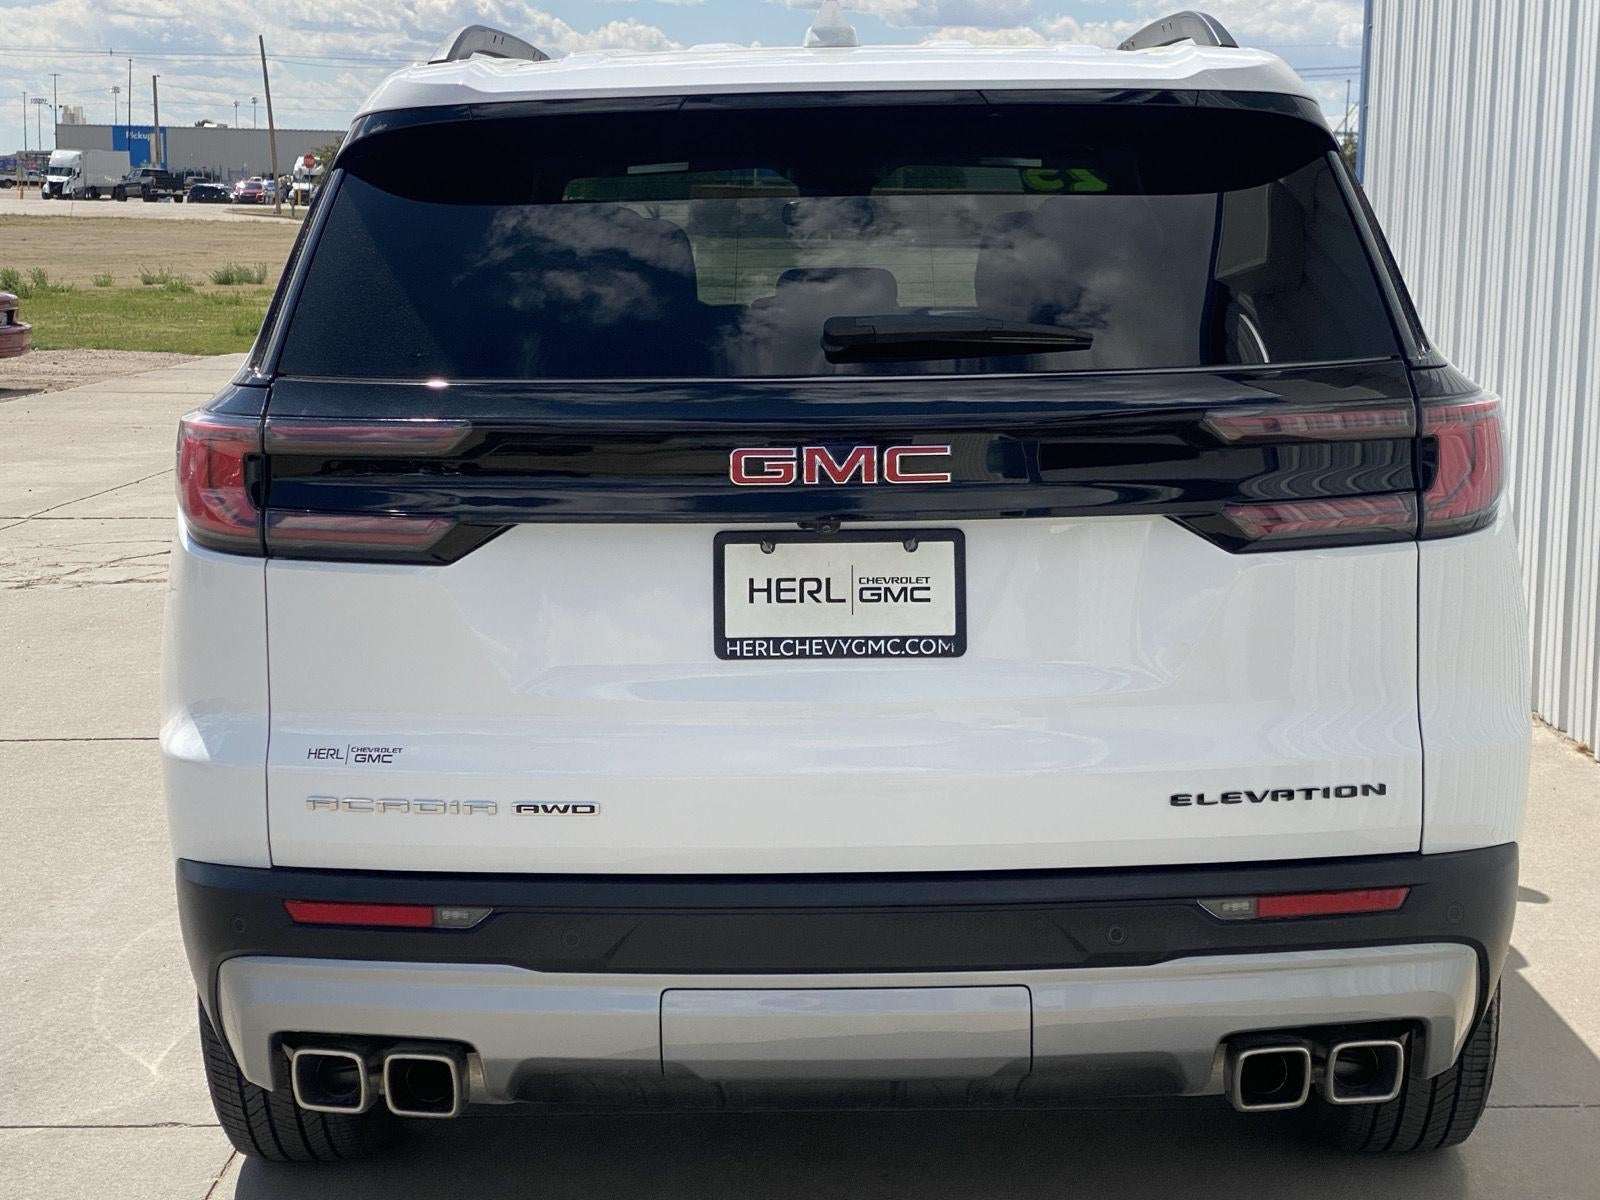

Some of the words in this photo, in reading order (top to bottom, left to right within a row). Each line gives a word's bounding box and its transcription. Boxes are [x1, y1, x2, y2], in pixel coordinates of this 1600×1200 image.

[729, 446, 951, 485] GMC
[858, 576, 931, 585] CHEVROLET
[748, 577, 846, 604] HERL
[858, 586, 931, 603] GMC
[726, 638, 955, 657] HERLCHEVYGMC.COM
[307, 748, 344, 760] HERL
[350, 746, 403, 754] CHEVROLET
[354, 753, 393, 764] GMC
[1169, 783, 1387, 807] ELEVATION
[305, 796, 498, 815] ACADIA
[514, 802, 597, 815] AWD
